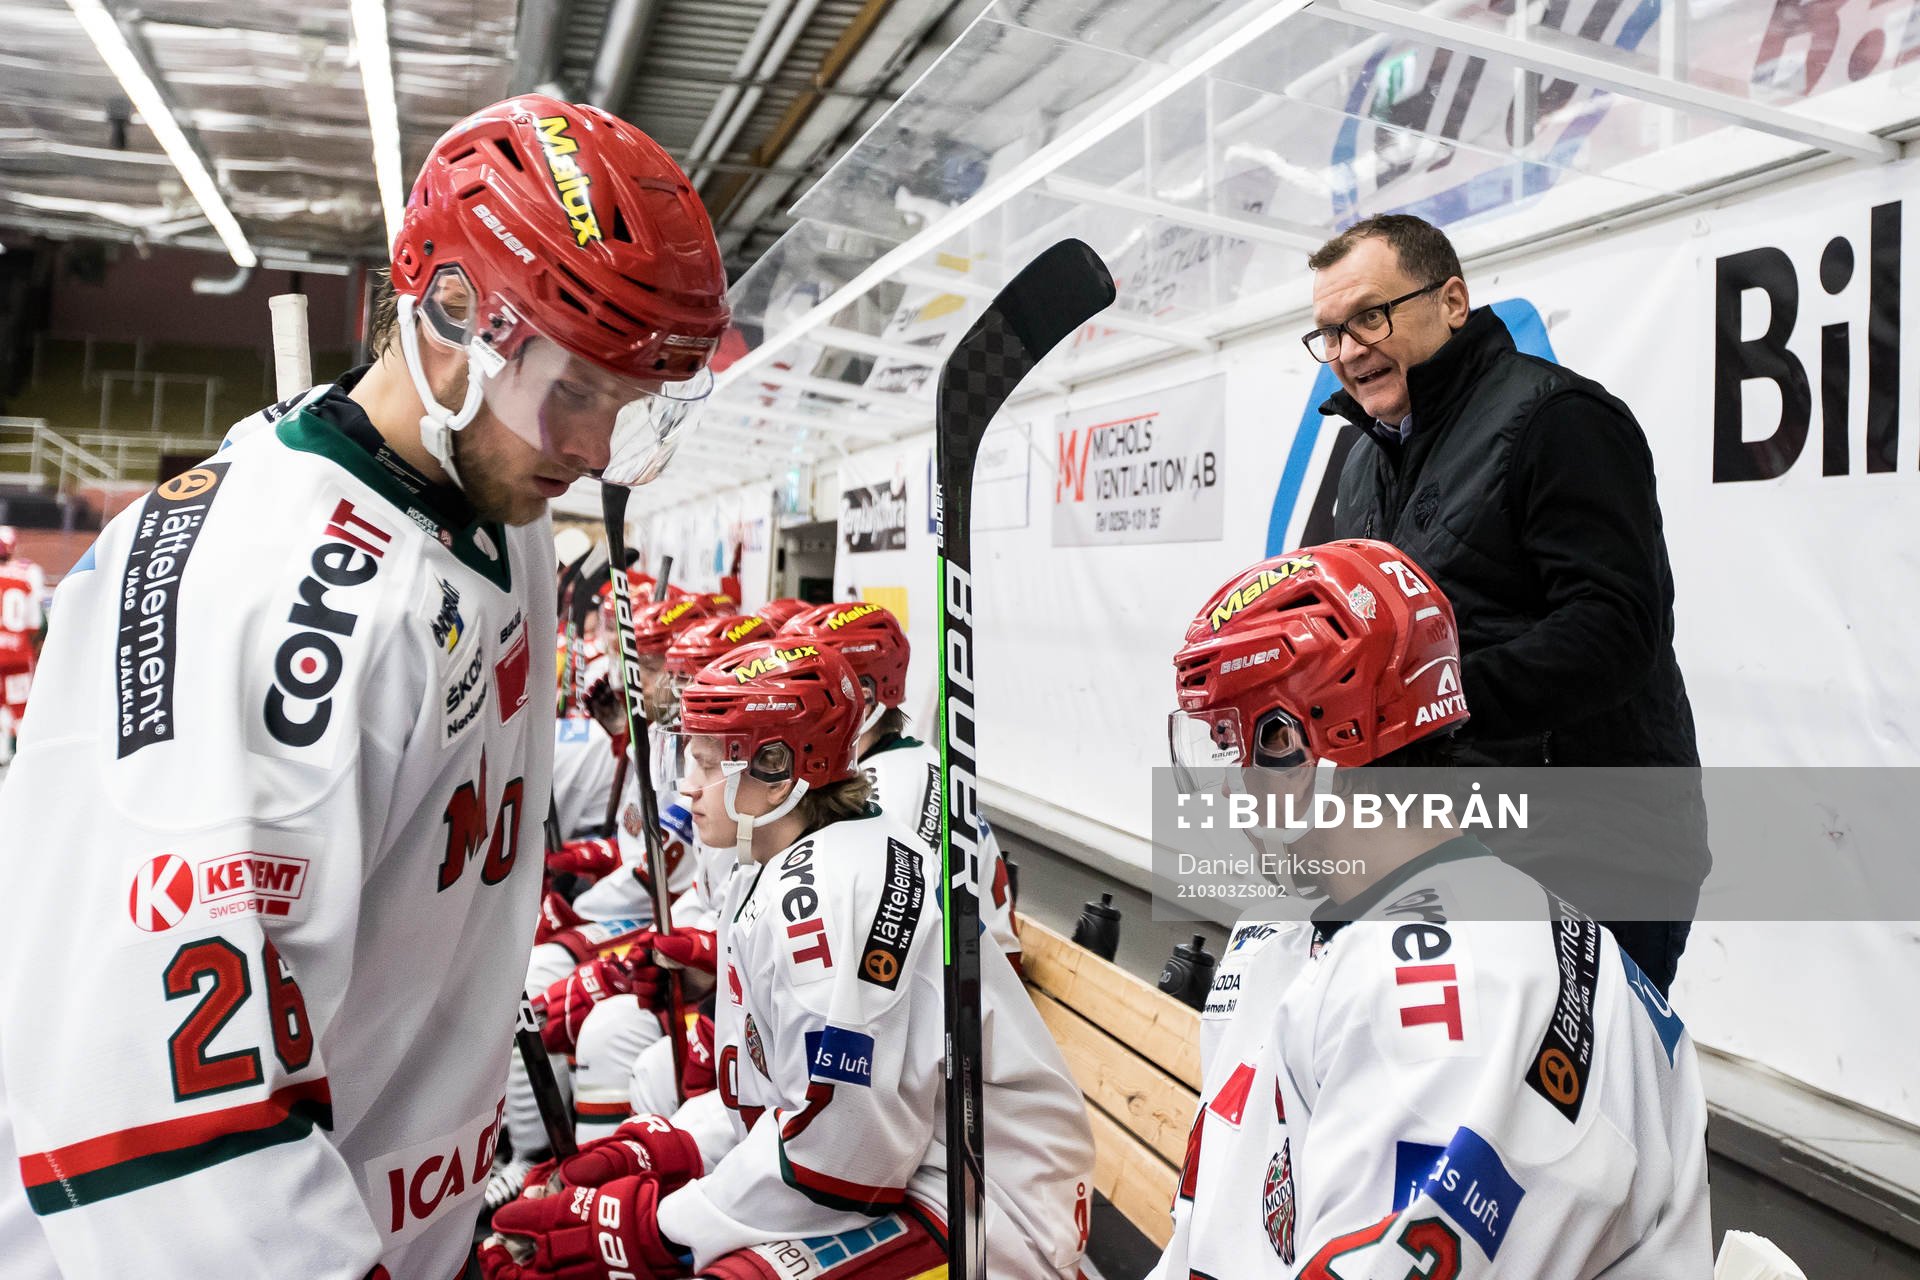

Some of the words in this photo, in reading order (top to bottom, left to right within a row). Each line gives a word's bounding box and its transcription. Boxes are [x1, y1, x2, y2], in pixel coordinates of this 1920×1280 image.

[535, 115, 603, 248] Malux
[471, 202, 536, 265] BAUER
[1713, 200, 1902, 483] Bil
[1094, 456, 1187, 500] VENTILATION
[1190, 451, 1217, 490] AB
[140, 510, 160, 540] TAK
[406, 506, 438, 532] HOCKEY
[1211, 553, 1316, 634] Malux
[1379, 560, 1430, 598] 23
[263, 498, 394, 749] coreIT
[828, 604, 881, 631] Malux
[613, 569, 647, 719] BAUER
[734, 643, 819, 685] Malux
[1219, 647, 1281, 677] BAUER
[745, 701, 797, 712] BAUER
[945, 558, 980, 898] BAUER
[899, 929, 912, 950] TAK
[1553, 901, 1582, 1052] lättelemen
[162, 936, 314, 1103] 26
[1580, 1041, 1591, 1065] TAK
[388, 1145, 464, 1233] ICA
[1265, 1181, 1292, 1216] MODO
